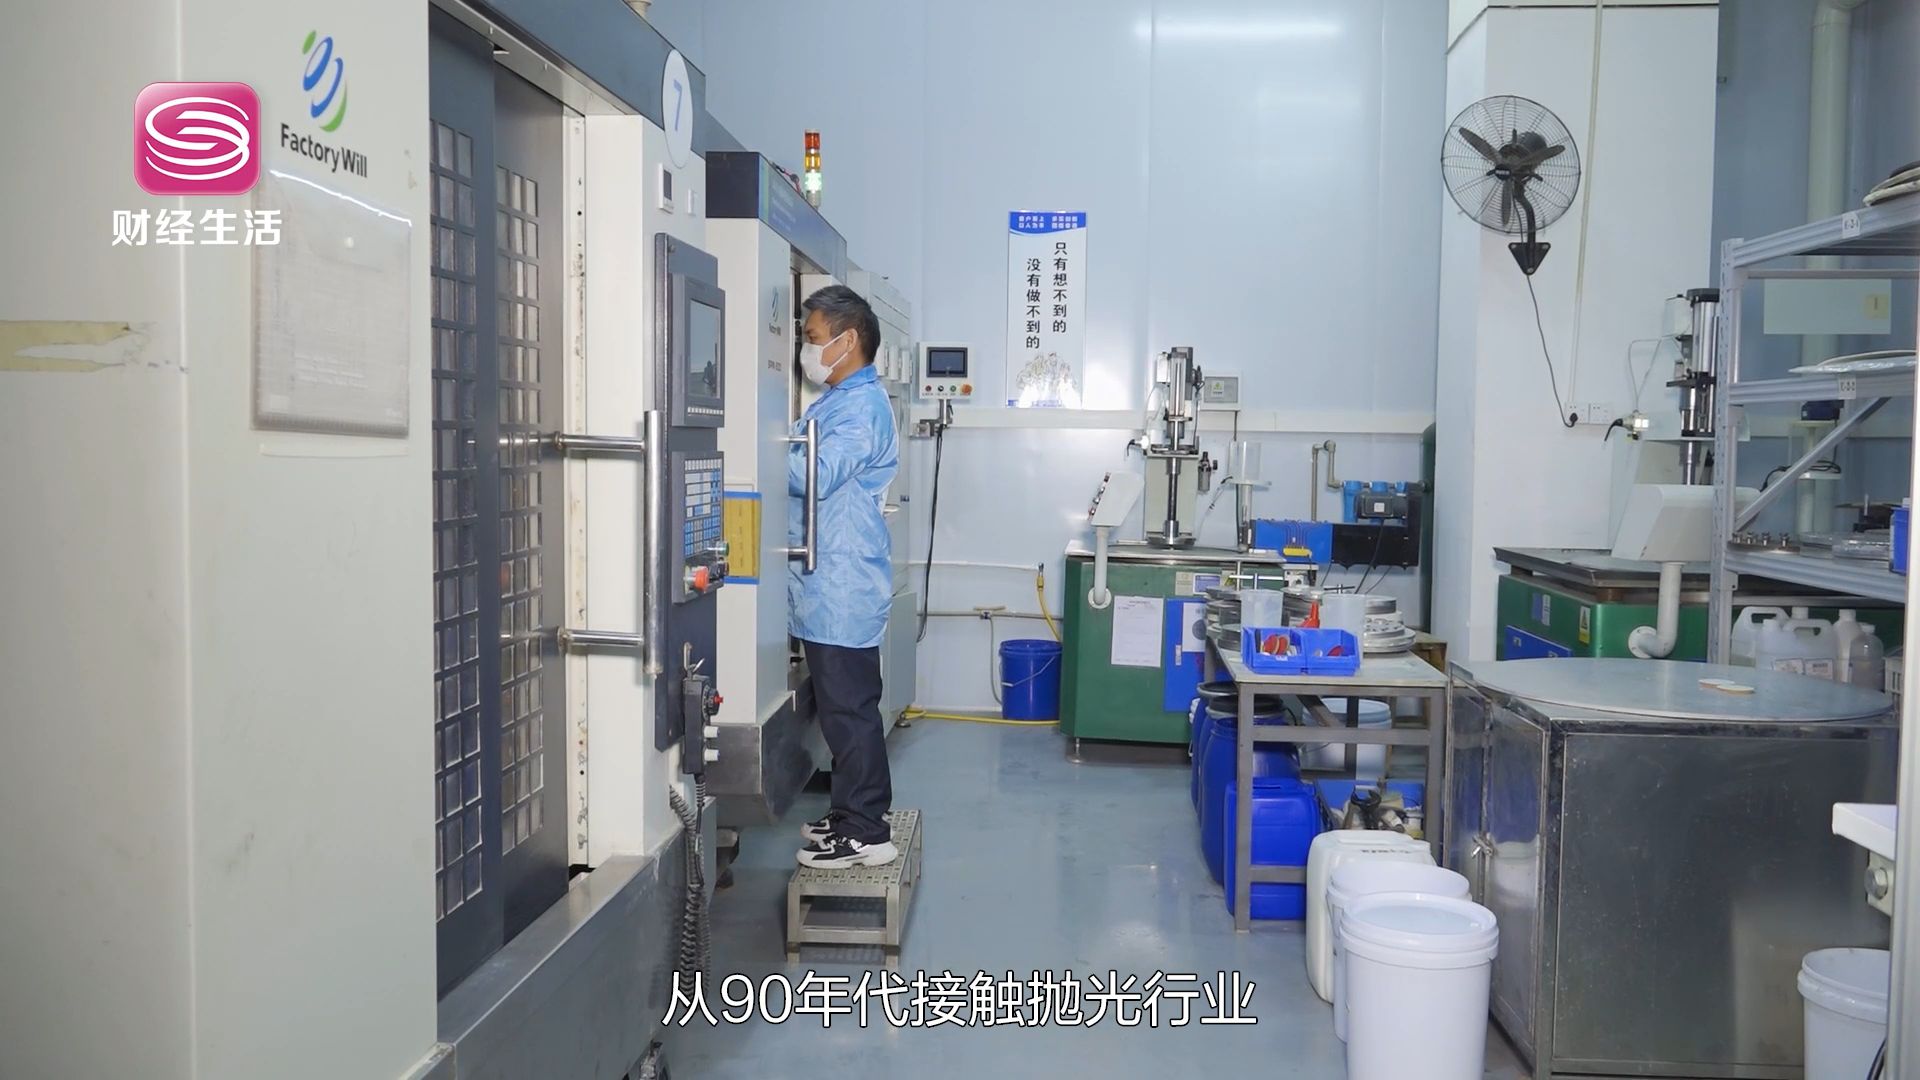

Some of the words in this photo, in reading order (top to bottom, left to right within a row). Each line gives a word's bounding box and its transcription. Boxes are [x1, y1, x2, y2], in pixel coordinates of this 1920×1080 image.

[673, 79, 683, 132] 7
[1025, 258, 1041, 350] 没有做不到的
[1053, 242, 1068, 334] 只有想不到的
